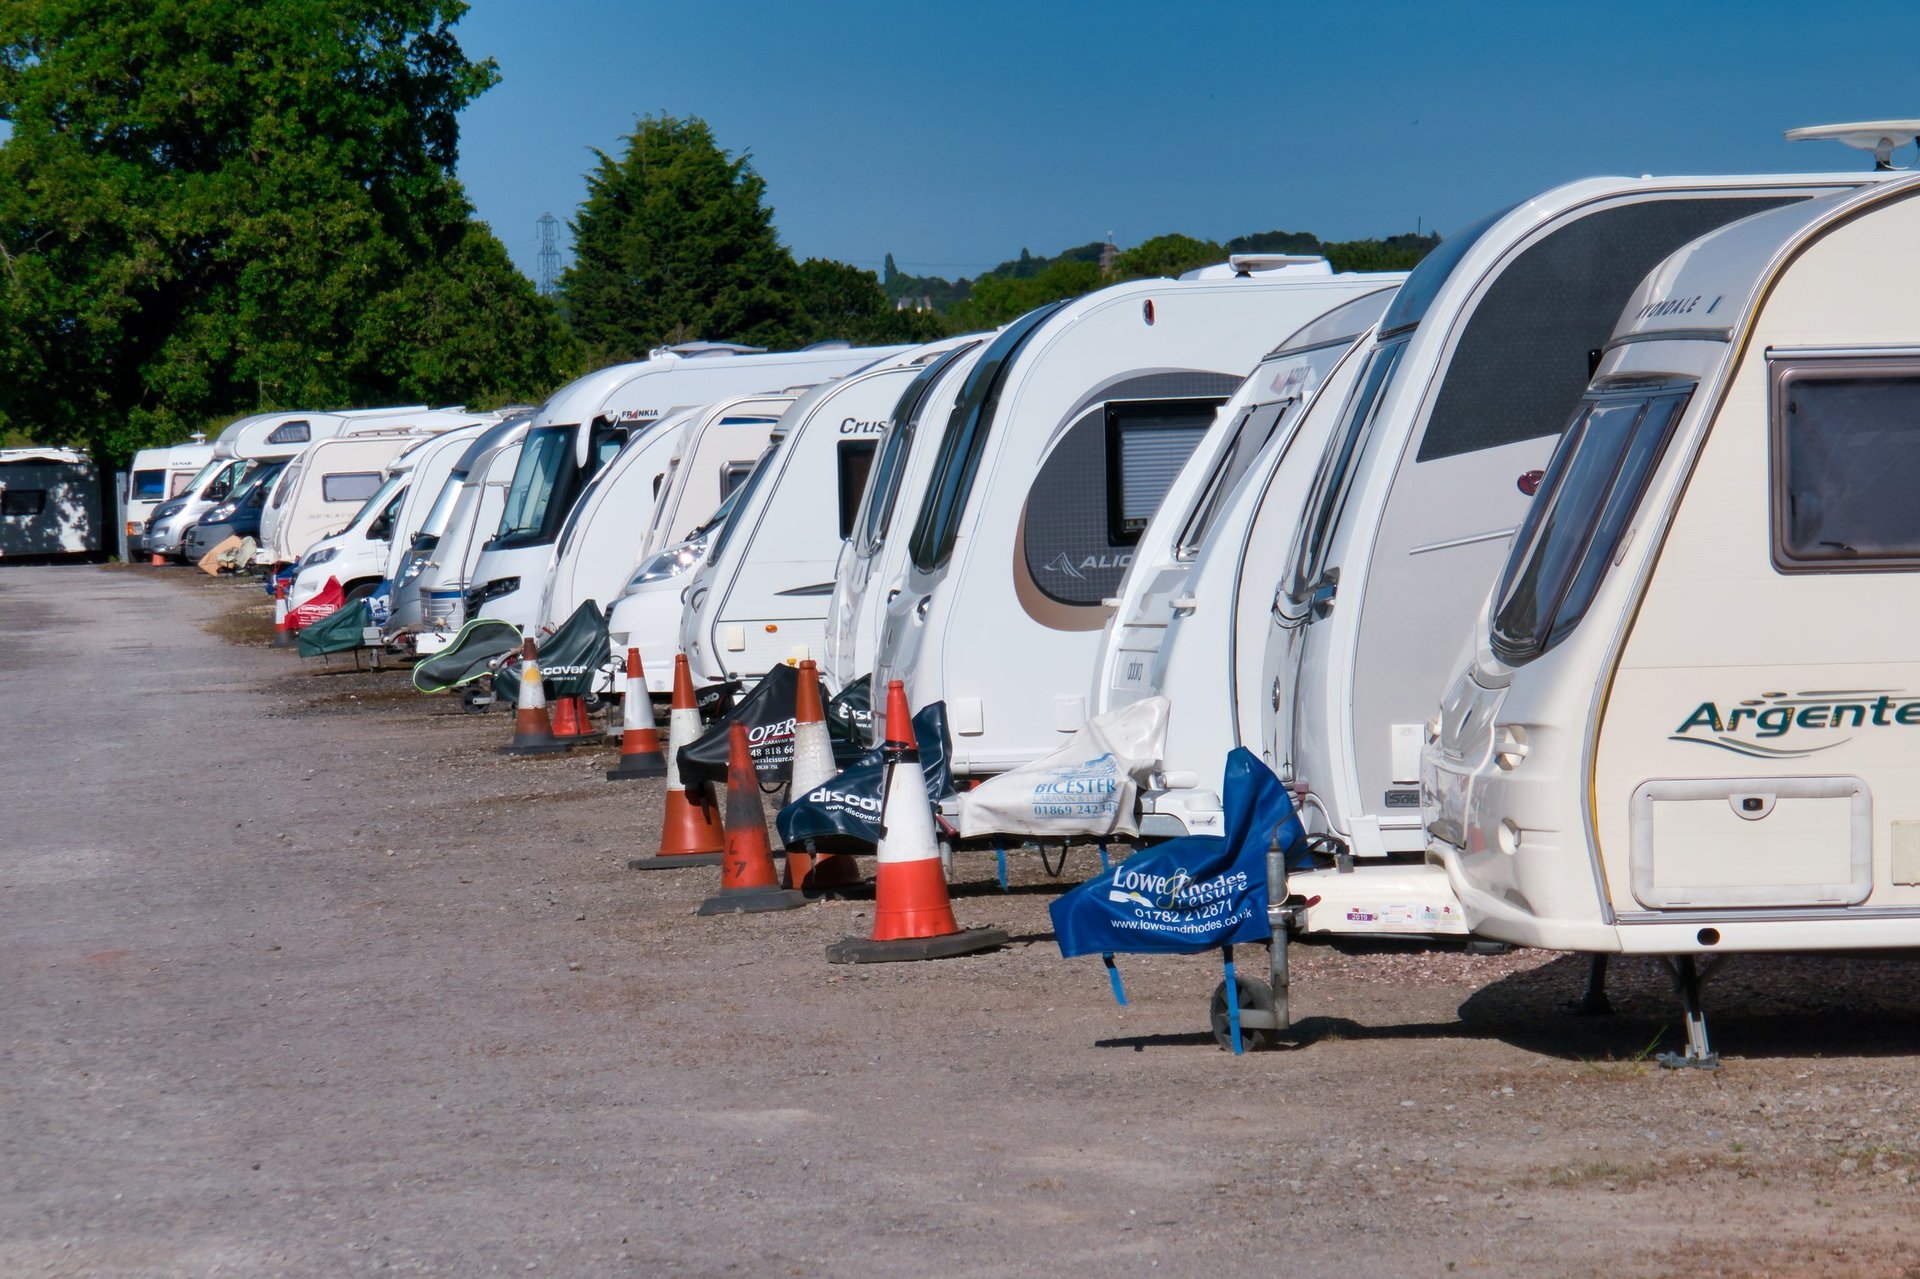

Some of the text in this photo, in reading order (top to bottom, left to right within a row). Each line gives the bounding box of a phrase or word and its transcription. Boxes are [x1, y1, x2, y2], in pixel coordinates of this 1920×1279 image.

[622, 409, 658, 419] FRANKIA
[540, 665, 588, 676] cover
[1675, 695, 1920, 738] Argente
[765, 746, 782, 756] 818
[1034, 778, 1117, 794] BICESTER
[1033, 794, 1075, 802] CARAVAN
[1034, 805, 1072, 815] 01869
[1112, 865, 1165, 895] Lowe
[1135, 899, 1232, 923] 01782 212871
